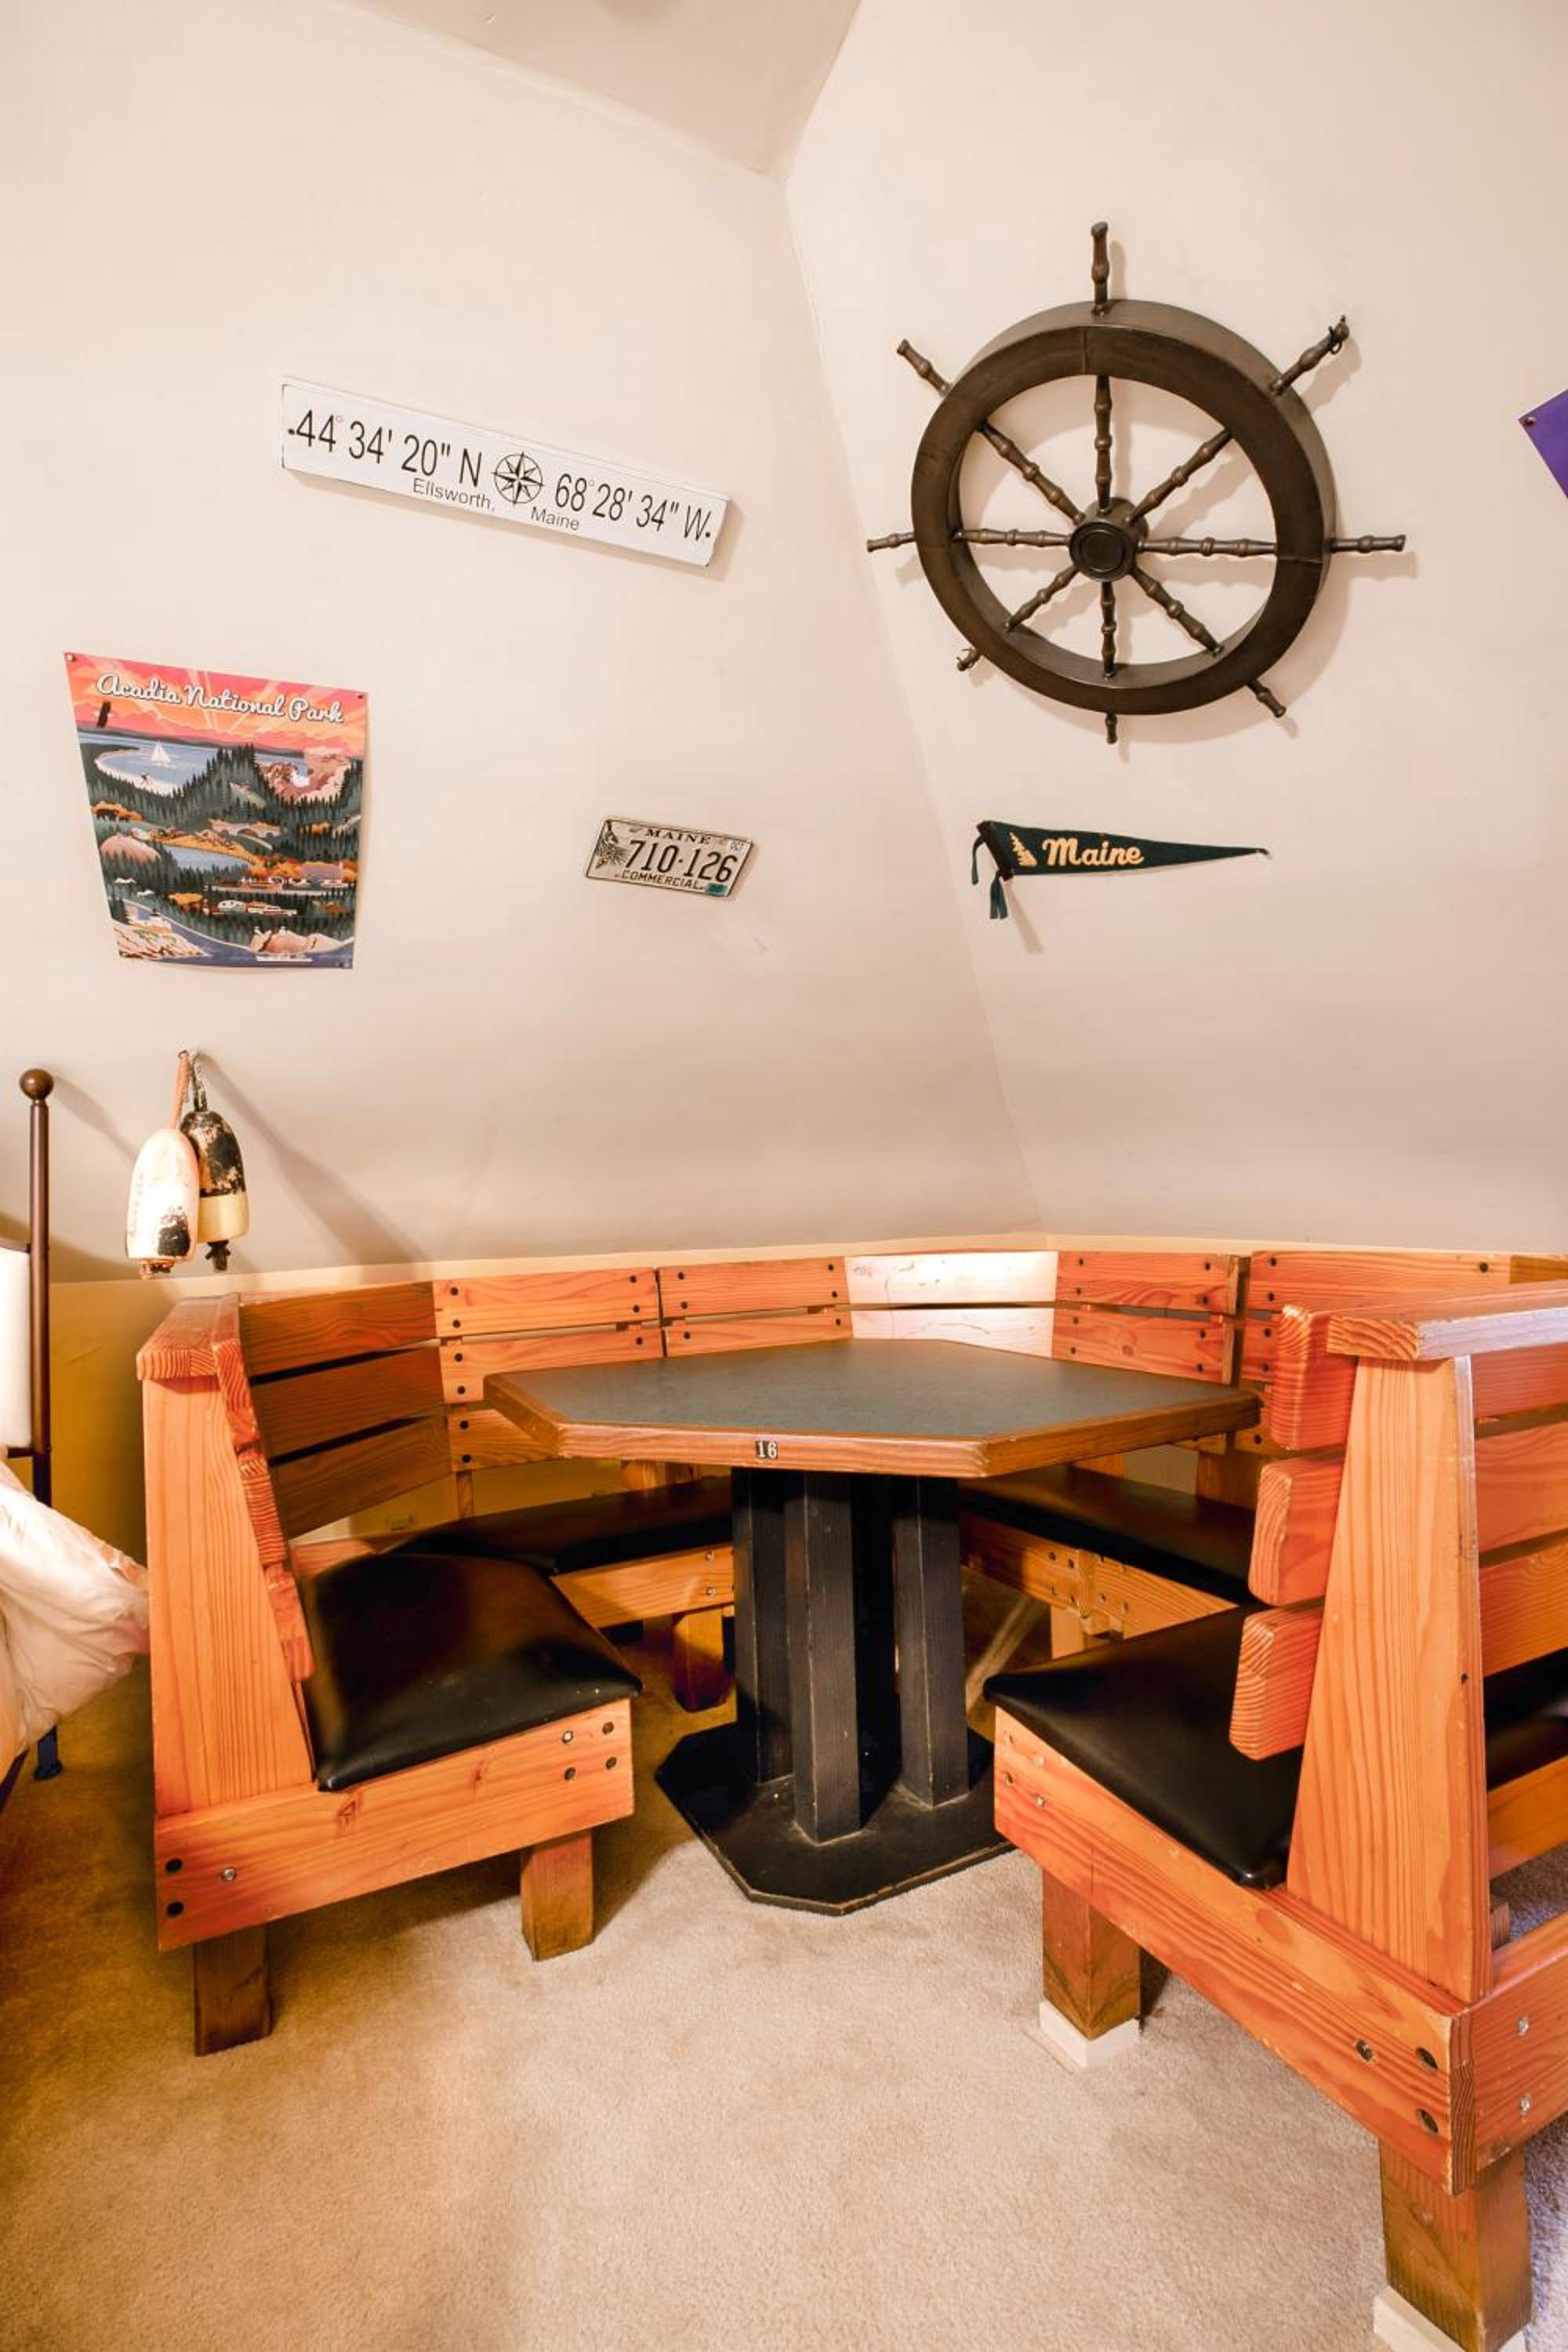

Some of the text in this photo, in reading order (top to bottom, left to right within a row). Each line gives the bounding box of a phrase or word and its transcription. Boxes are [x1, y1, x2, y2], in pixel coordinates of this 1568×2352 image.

[349, 420, 393, 464] 34'
[401, 434, 451, 476] 20"
[459, 448, 483, 488] N
[636, 494, 679, 532] 34"
[412, 477, 579, 531] Ellsworth, Maine
[96, 673, 345, 724] Acadia National Park
[645, 829, 712, 845] MAINE
[1041, 837, 1145, 866] Maine
[620, 869, 702, 890] COMMERCIAL
[757, 1441, 778, 1460] 16
